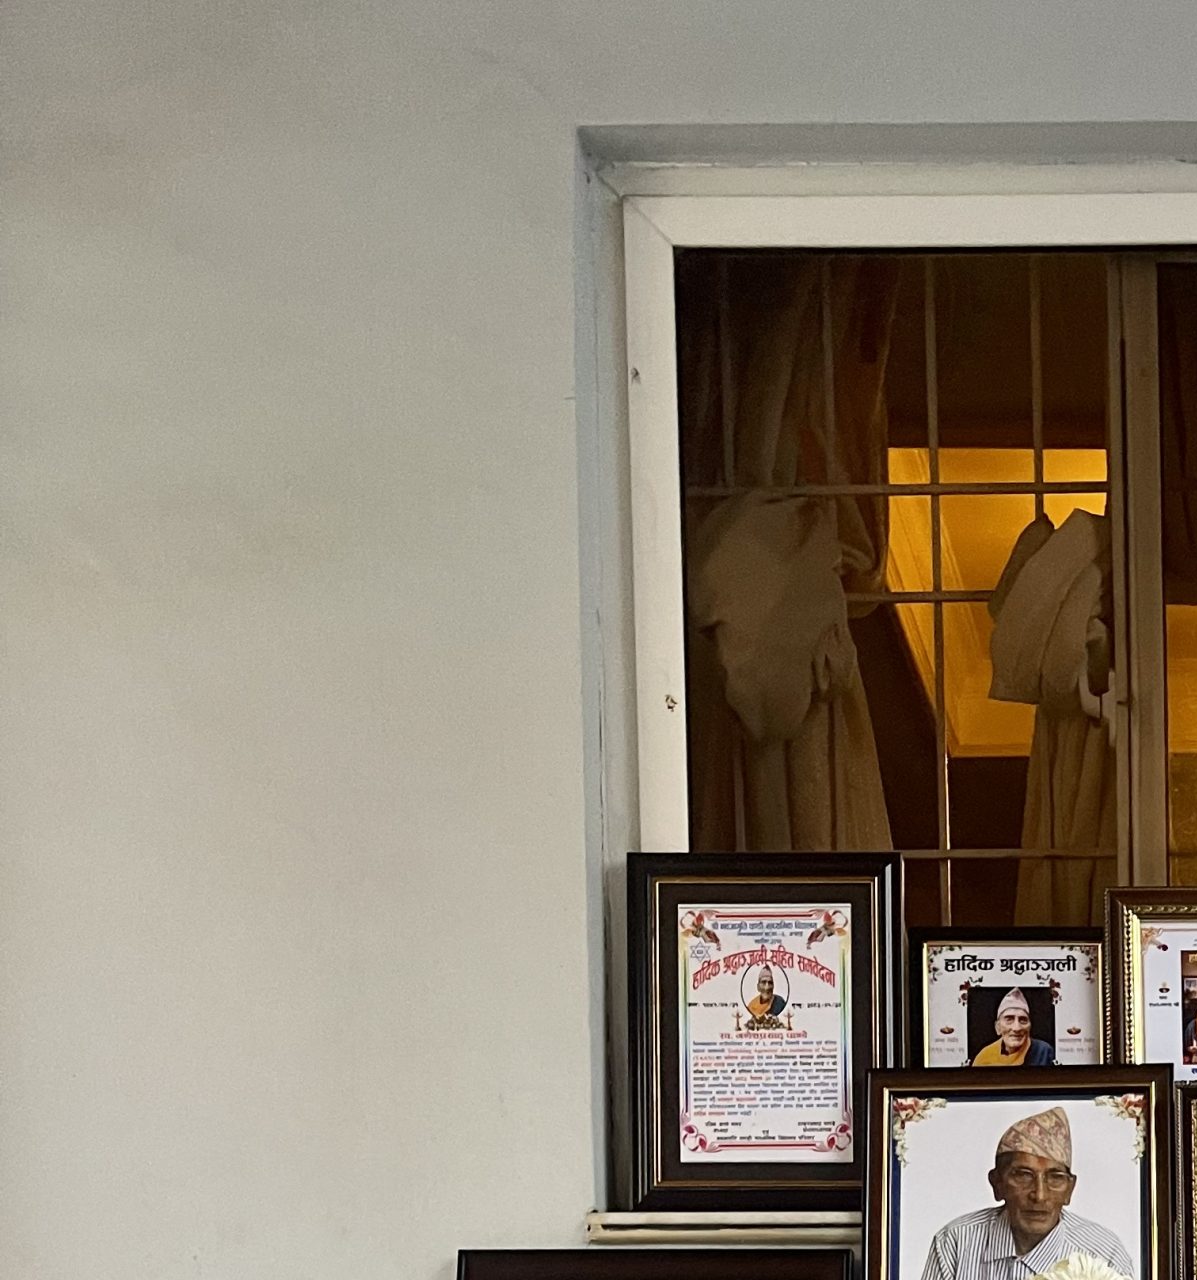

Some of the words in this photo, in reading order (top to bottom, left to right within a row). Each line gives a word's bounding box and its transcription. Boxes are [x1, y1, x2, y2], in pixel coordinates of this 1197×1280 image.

[692, 957, 721, 990] हार्दिक
[770, 945, 795, 968] सहित
[944, 954, 995, 973] हार्दिक
